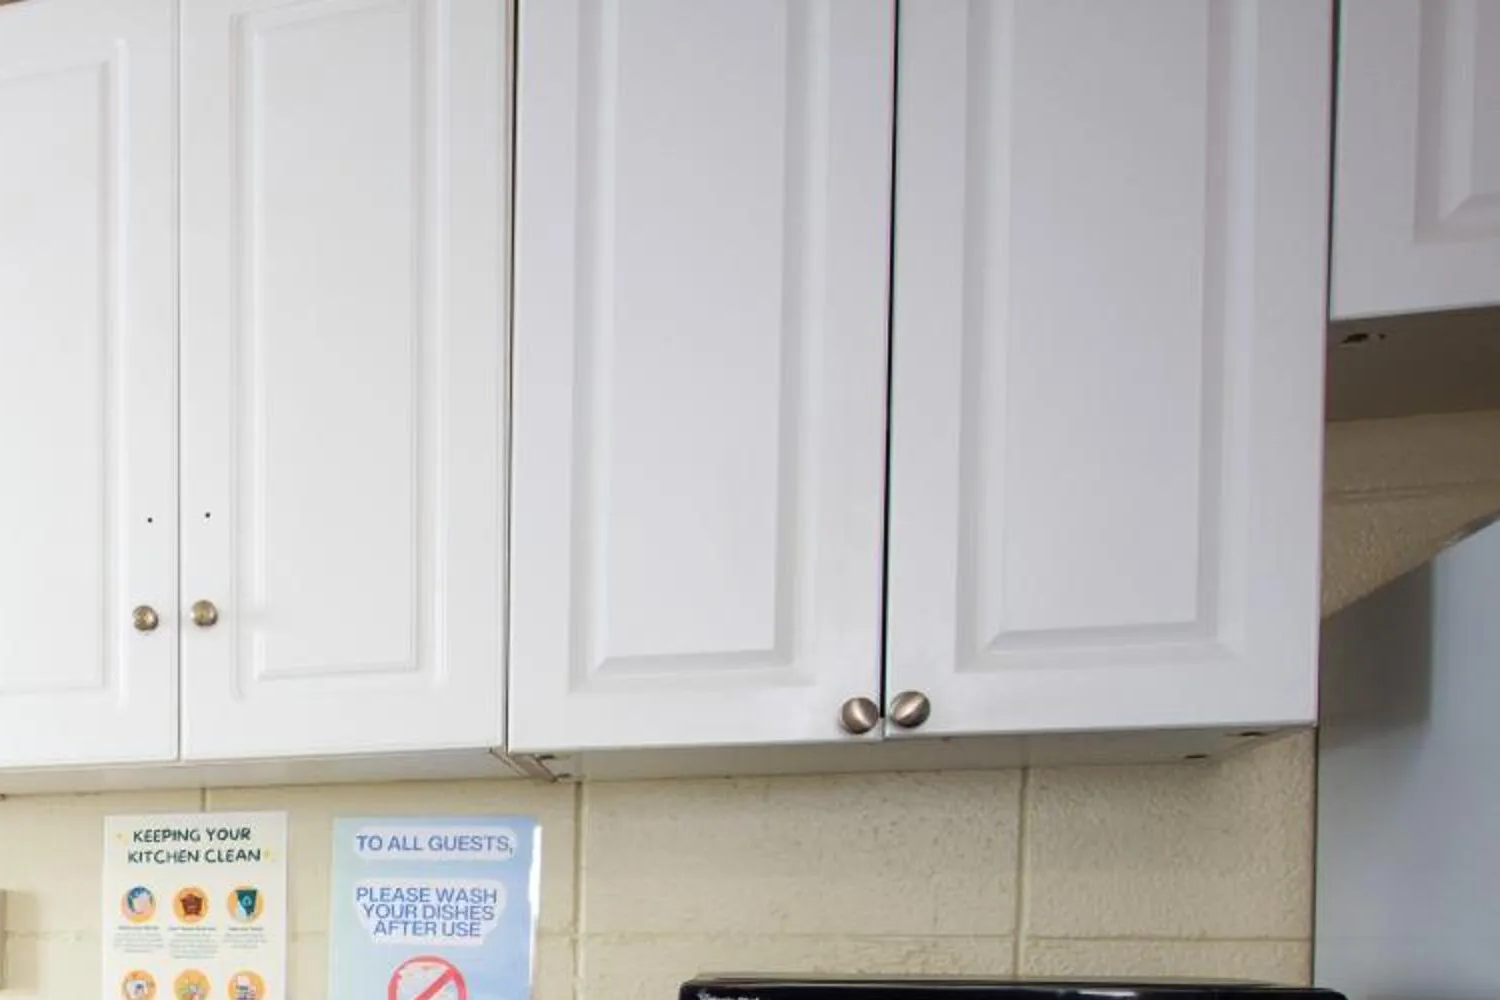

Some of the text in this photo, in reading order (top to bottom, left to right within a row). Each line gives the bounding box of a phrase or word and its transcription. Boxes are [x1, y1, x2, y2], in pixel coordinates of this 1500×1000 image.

[133, 827, 251, 843] KEEPING YOUR
[356, 835, 514, 854] TO ALL GUESTS,
[128, 848, 261, 864] KITCHEN CLEAN
[356, 887, 497, 905] PLEASE WASH
[363, 903, 495, 921] YOUR DISHES
[373, 920, 482, 937] AFTER USE
